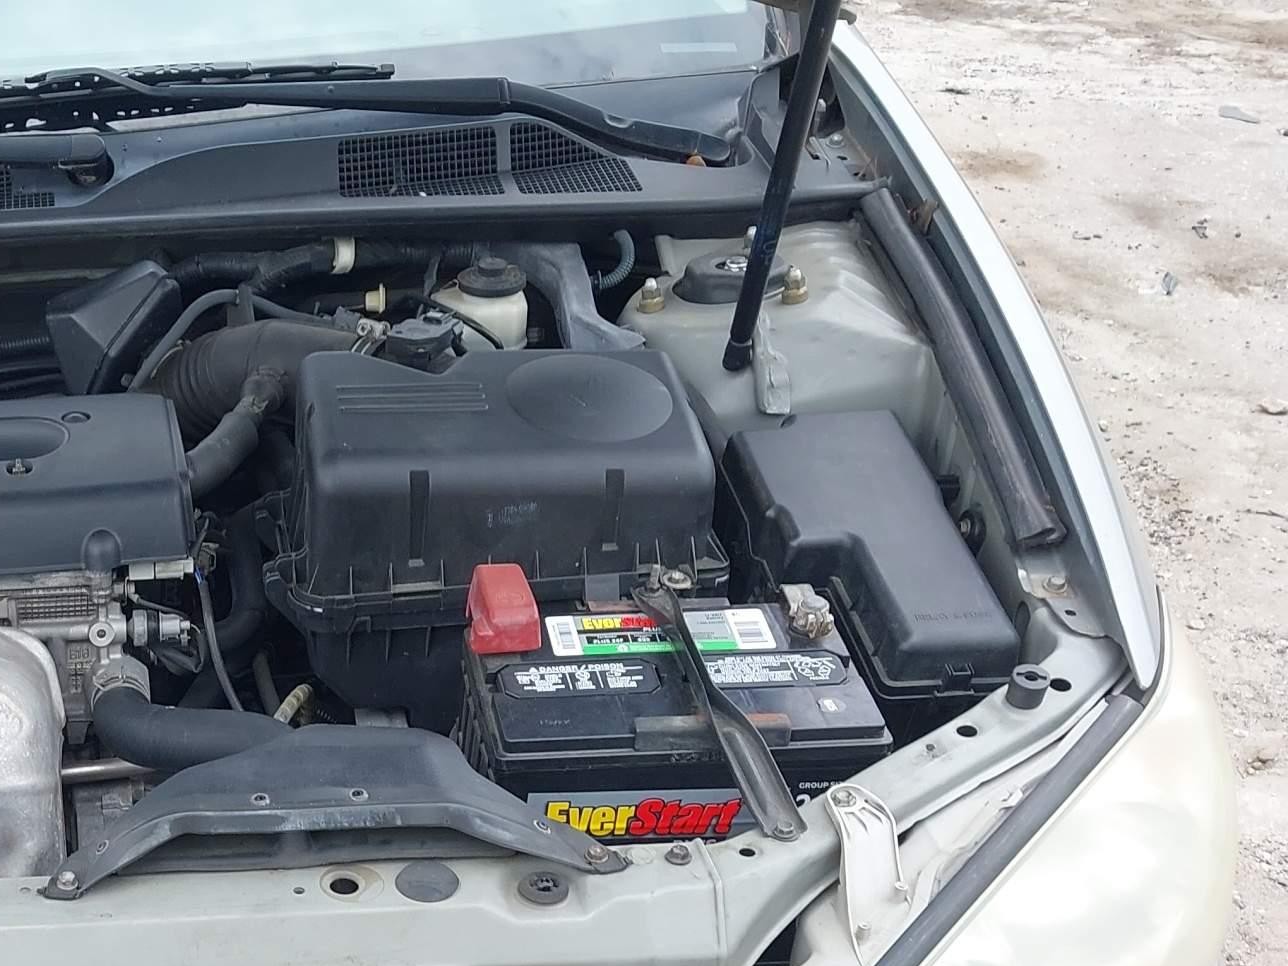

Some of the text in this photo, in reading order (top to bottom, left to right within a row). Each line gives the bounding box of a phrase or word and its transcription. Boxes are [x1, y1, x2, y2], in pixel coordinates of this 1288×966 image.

[581, 616, 656, 631] EverSta
[798, 781, 830, 790] GROUP
[546, 797, 745, 837] EverStart
